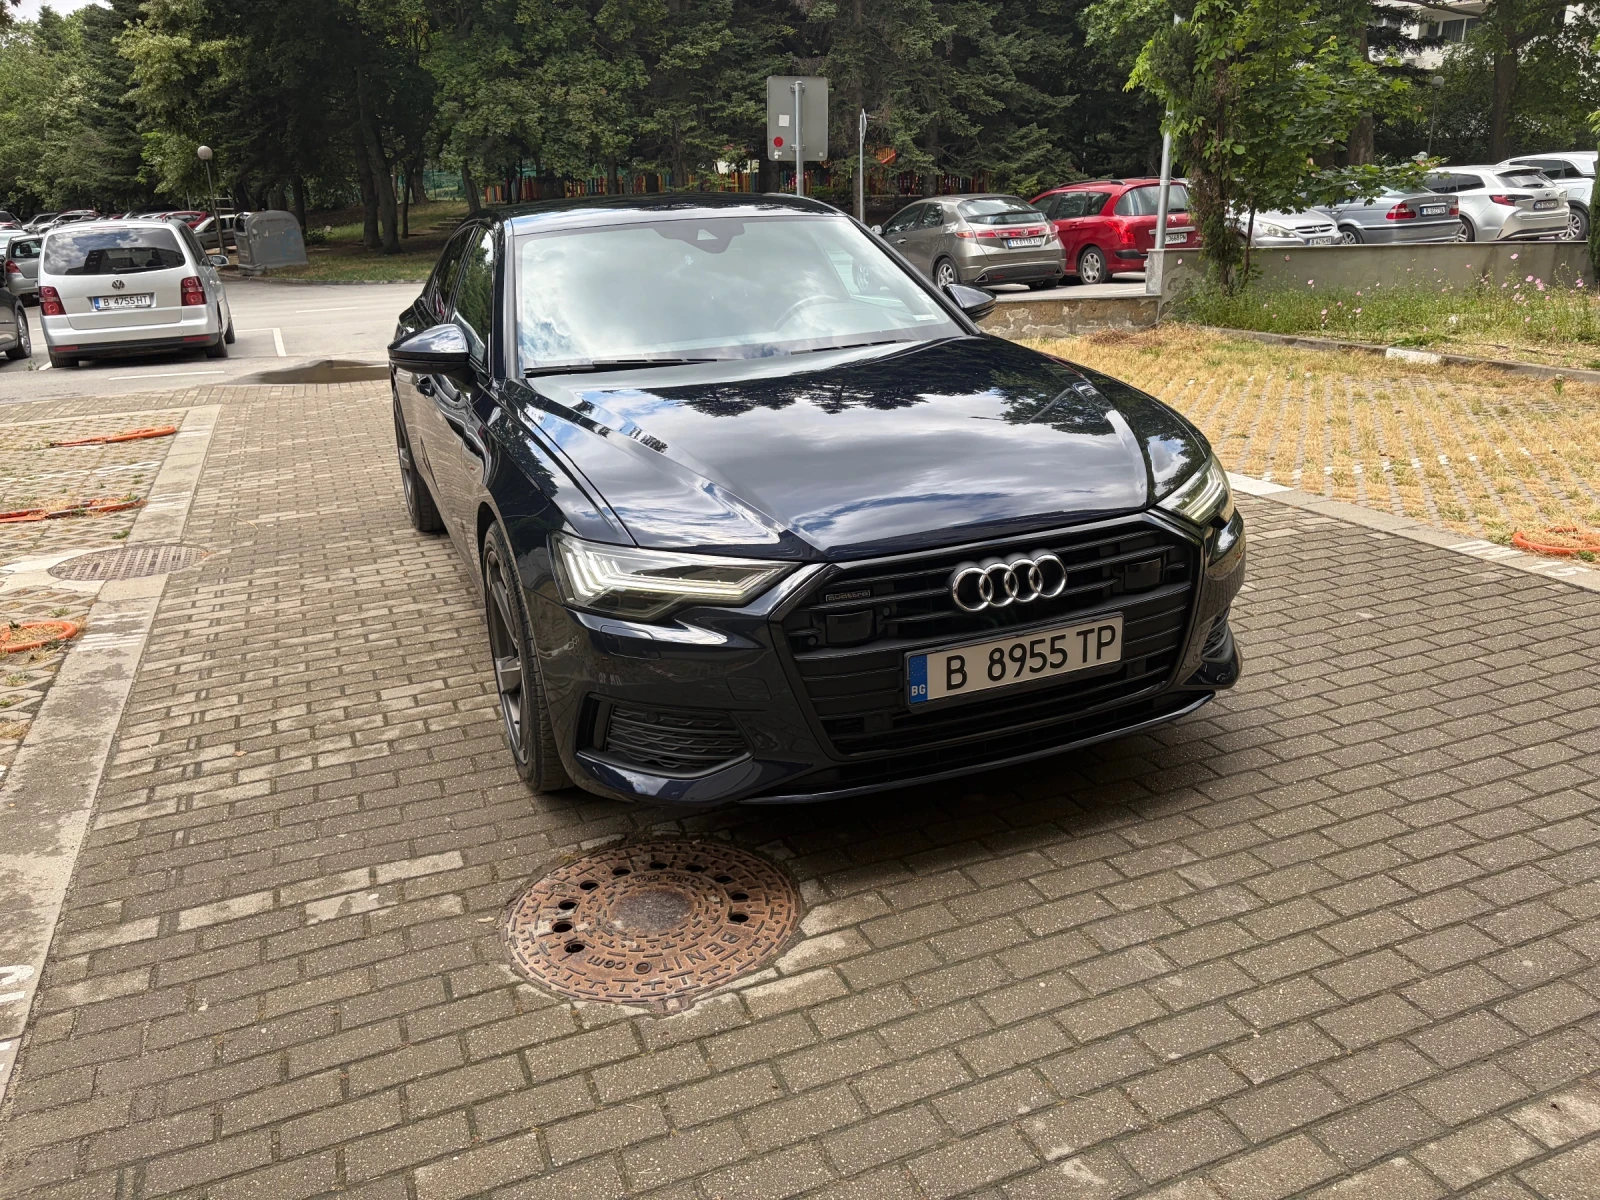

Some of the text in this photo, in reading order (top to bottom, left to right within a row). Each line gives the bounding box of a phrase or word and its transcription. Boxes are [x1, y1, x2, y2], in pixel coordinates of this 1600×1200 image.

[103, 298, 110, 307] B
[114, 296, 136, 306] 4755
[136, 295, 148, 304] HT
[911, 624, 1116, 697] BG B 8955 TP
